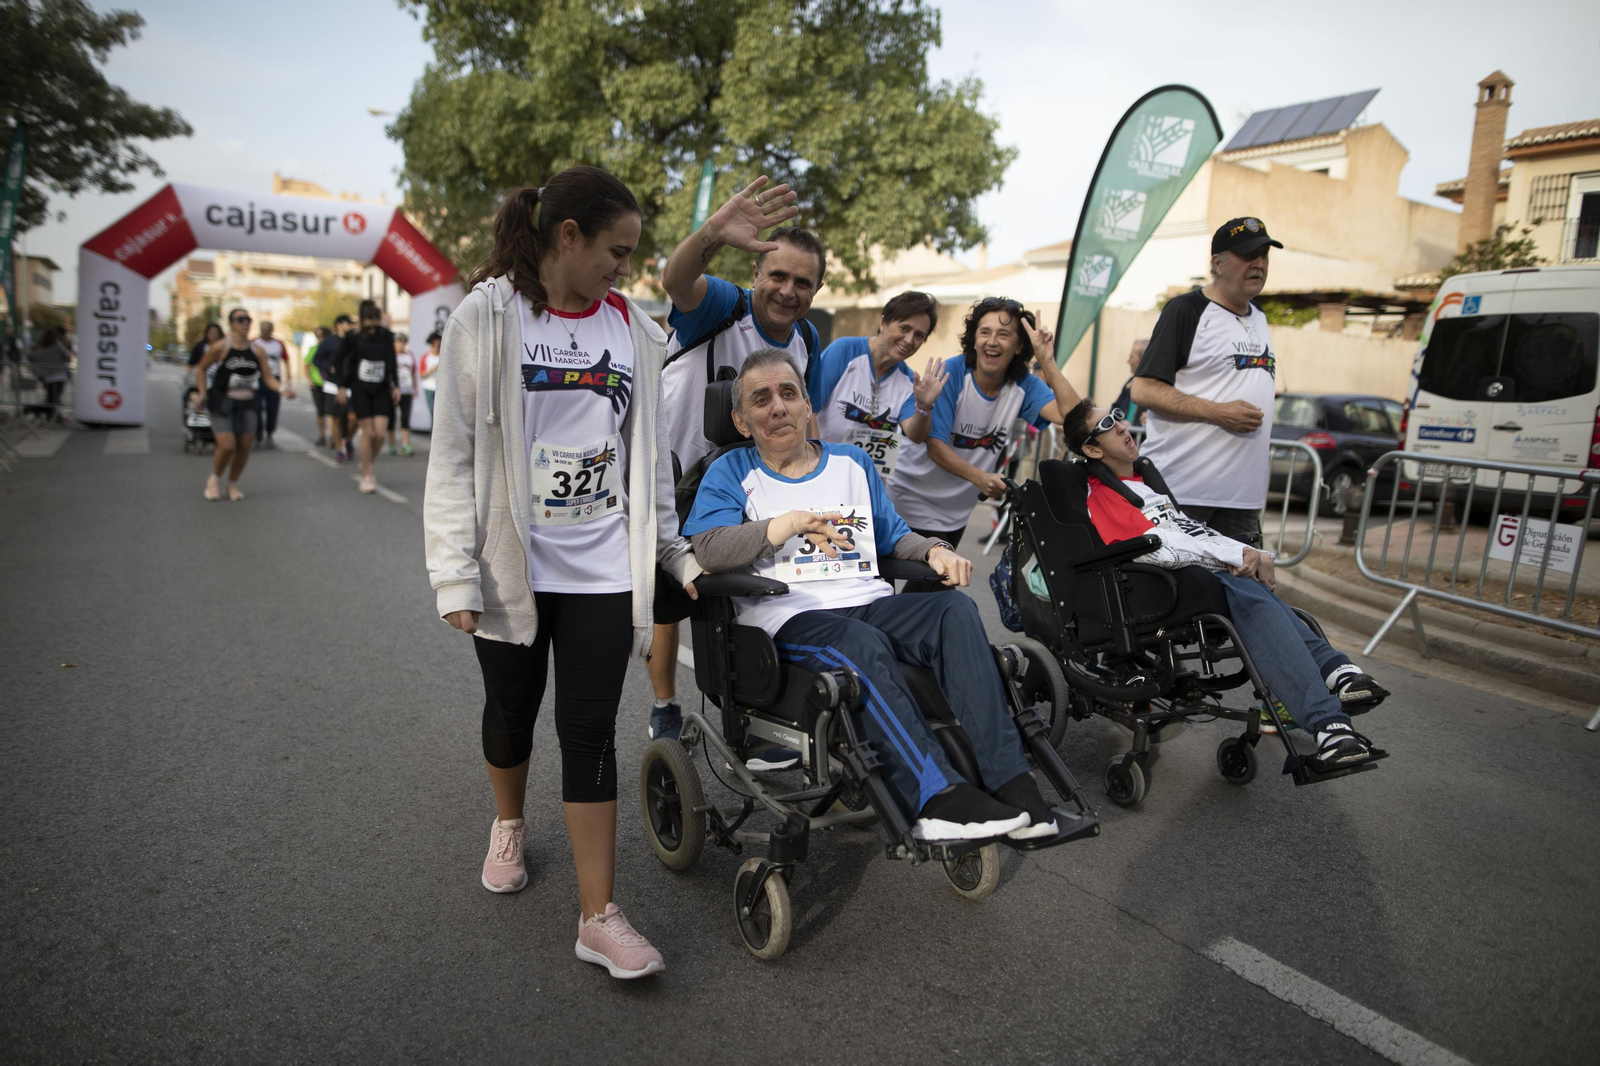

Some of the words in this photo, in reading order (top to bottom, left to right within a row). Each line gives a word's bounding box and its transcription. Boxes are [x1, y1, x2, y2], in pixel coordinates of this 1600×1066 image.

[205, 202, 338, 235] cajasur
[114, 219, 168, 261] cajasur
[388, 231, 435, 275] cajasur
[94, 281, 126, 386] cajasur
[524, 343, 552, 362] VII
[553, 348, 590, 358] CARRERA
[555, 357, 592, 365] MARCHA
[1240, 357, 1273, 366] ASPACE
[531, 370, 620, 387] ASPACE
[1420, 428, 1456, 439] Carrefour
[560, 451, 582, 460] CARRERA
[551, 463, 607, 498] 327
[1523, 527, 1573, 543] Diputción
